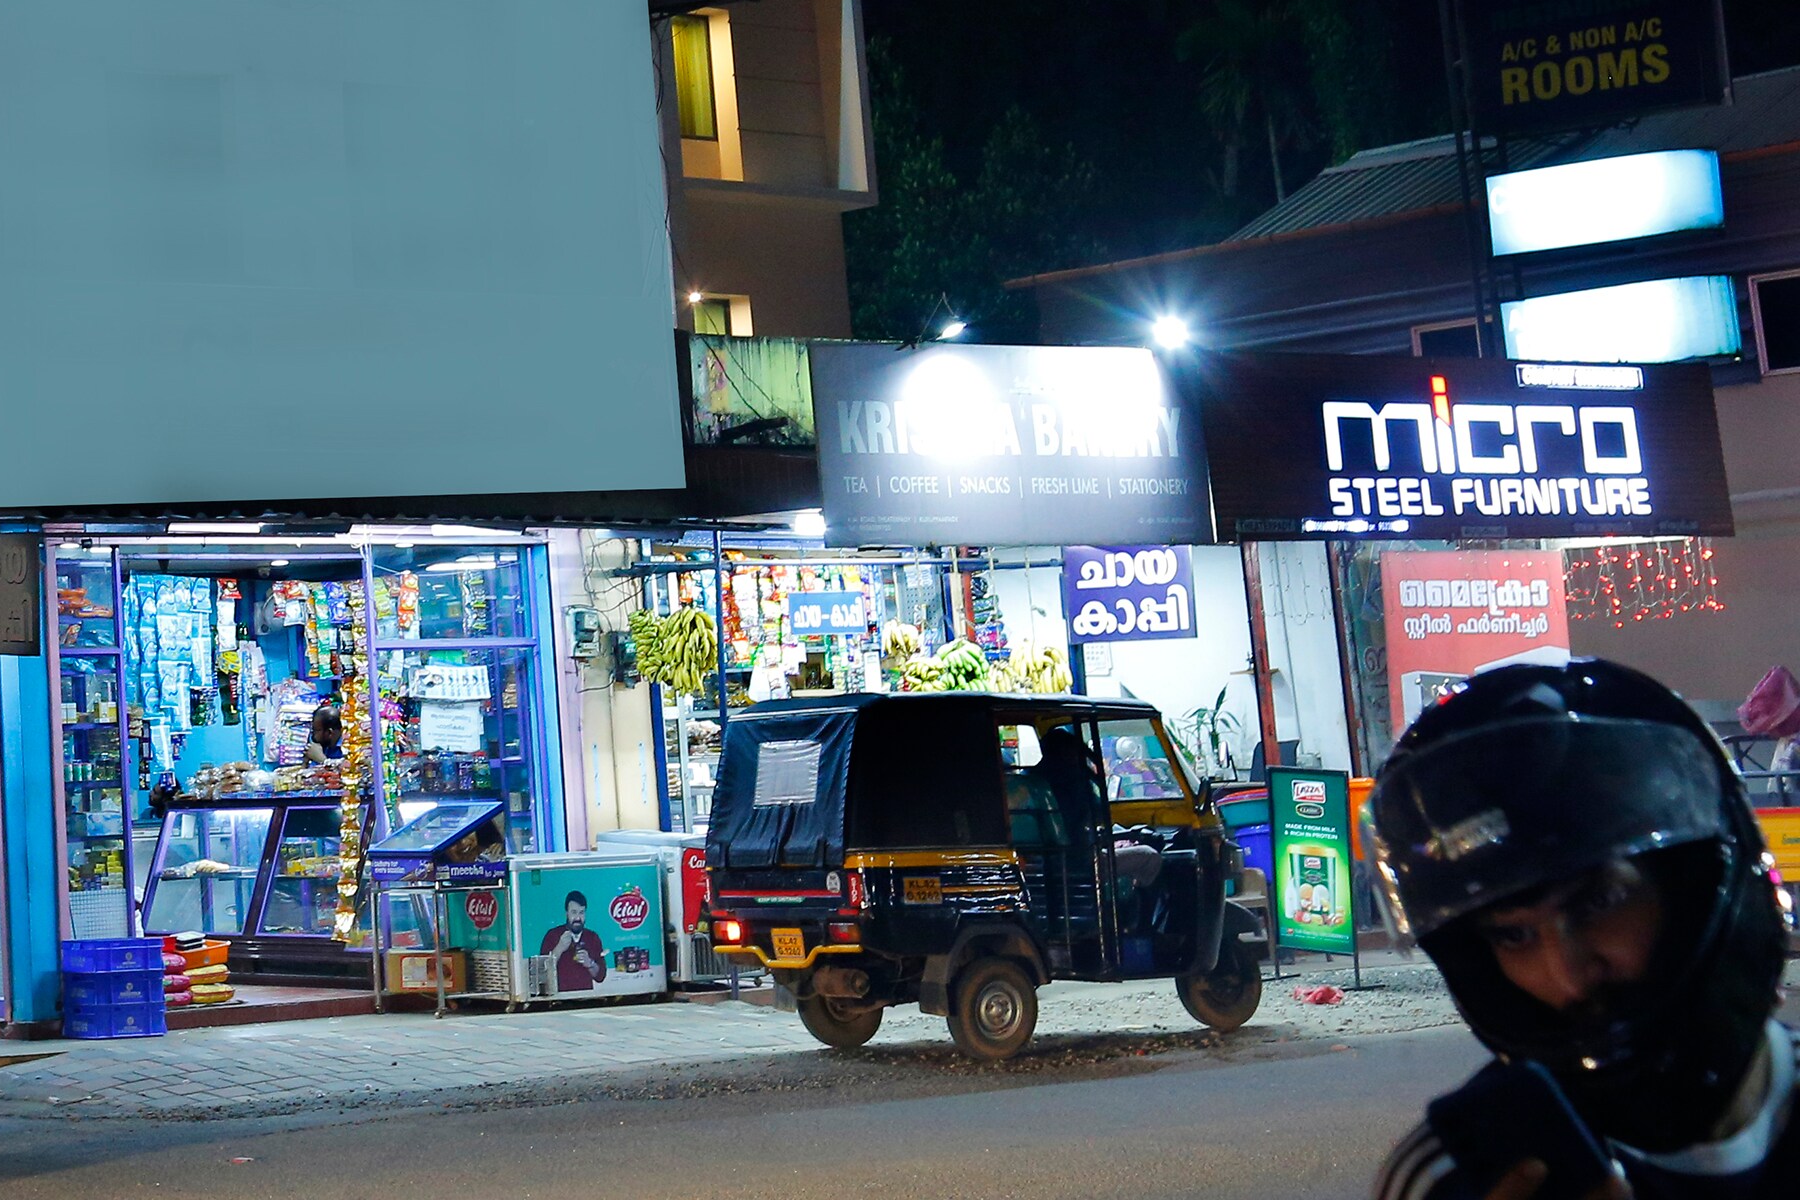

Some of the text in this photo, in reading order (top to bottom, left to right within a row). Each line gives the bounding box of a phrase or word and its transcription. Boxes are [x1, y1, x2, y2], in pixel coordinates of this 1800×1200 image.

[1502, 16, 1663, 62] A/C & NON A/C
[1500, 42, 1671, 106] ROOMS
[843, 476, 1189, 495] TEA COFFEE SNACKS FRESH LIME STATIONERY
[1329, 477, 1653, 517] STEEL FURNITURE
[1075, 548, 1177, 591] ചായ
[1072, 583, 1191, 637] കാപ്പി
[450, 865, 484, 876] meetha
